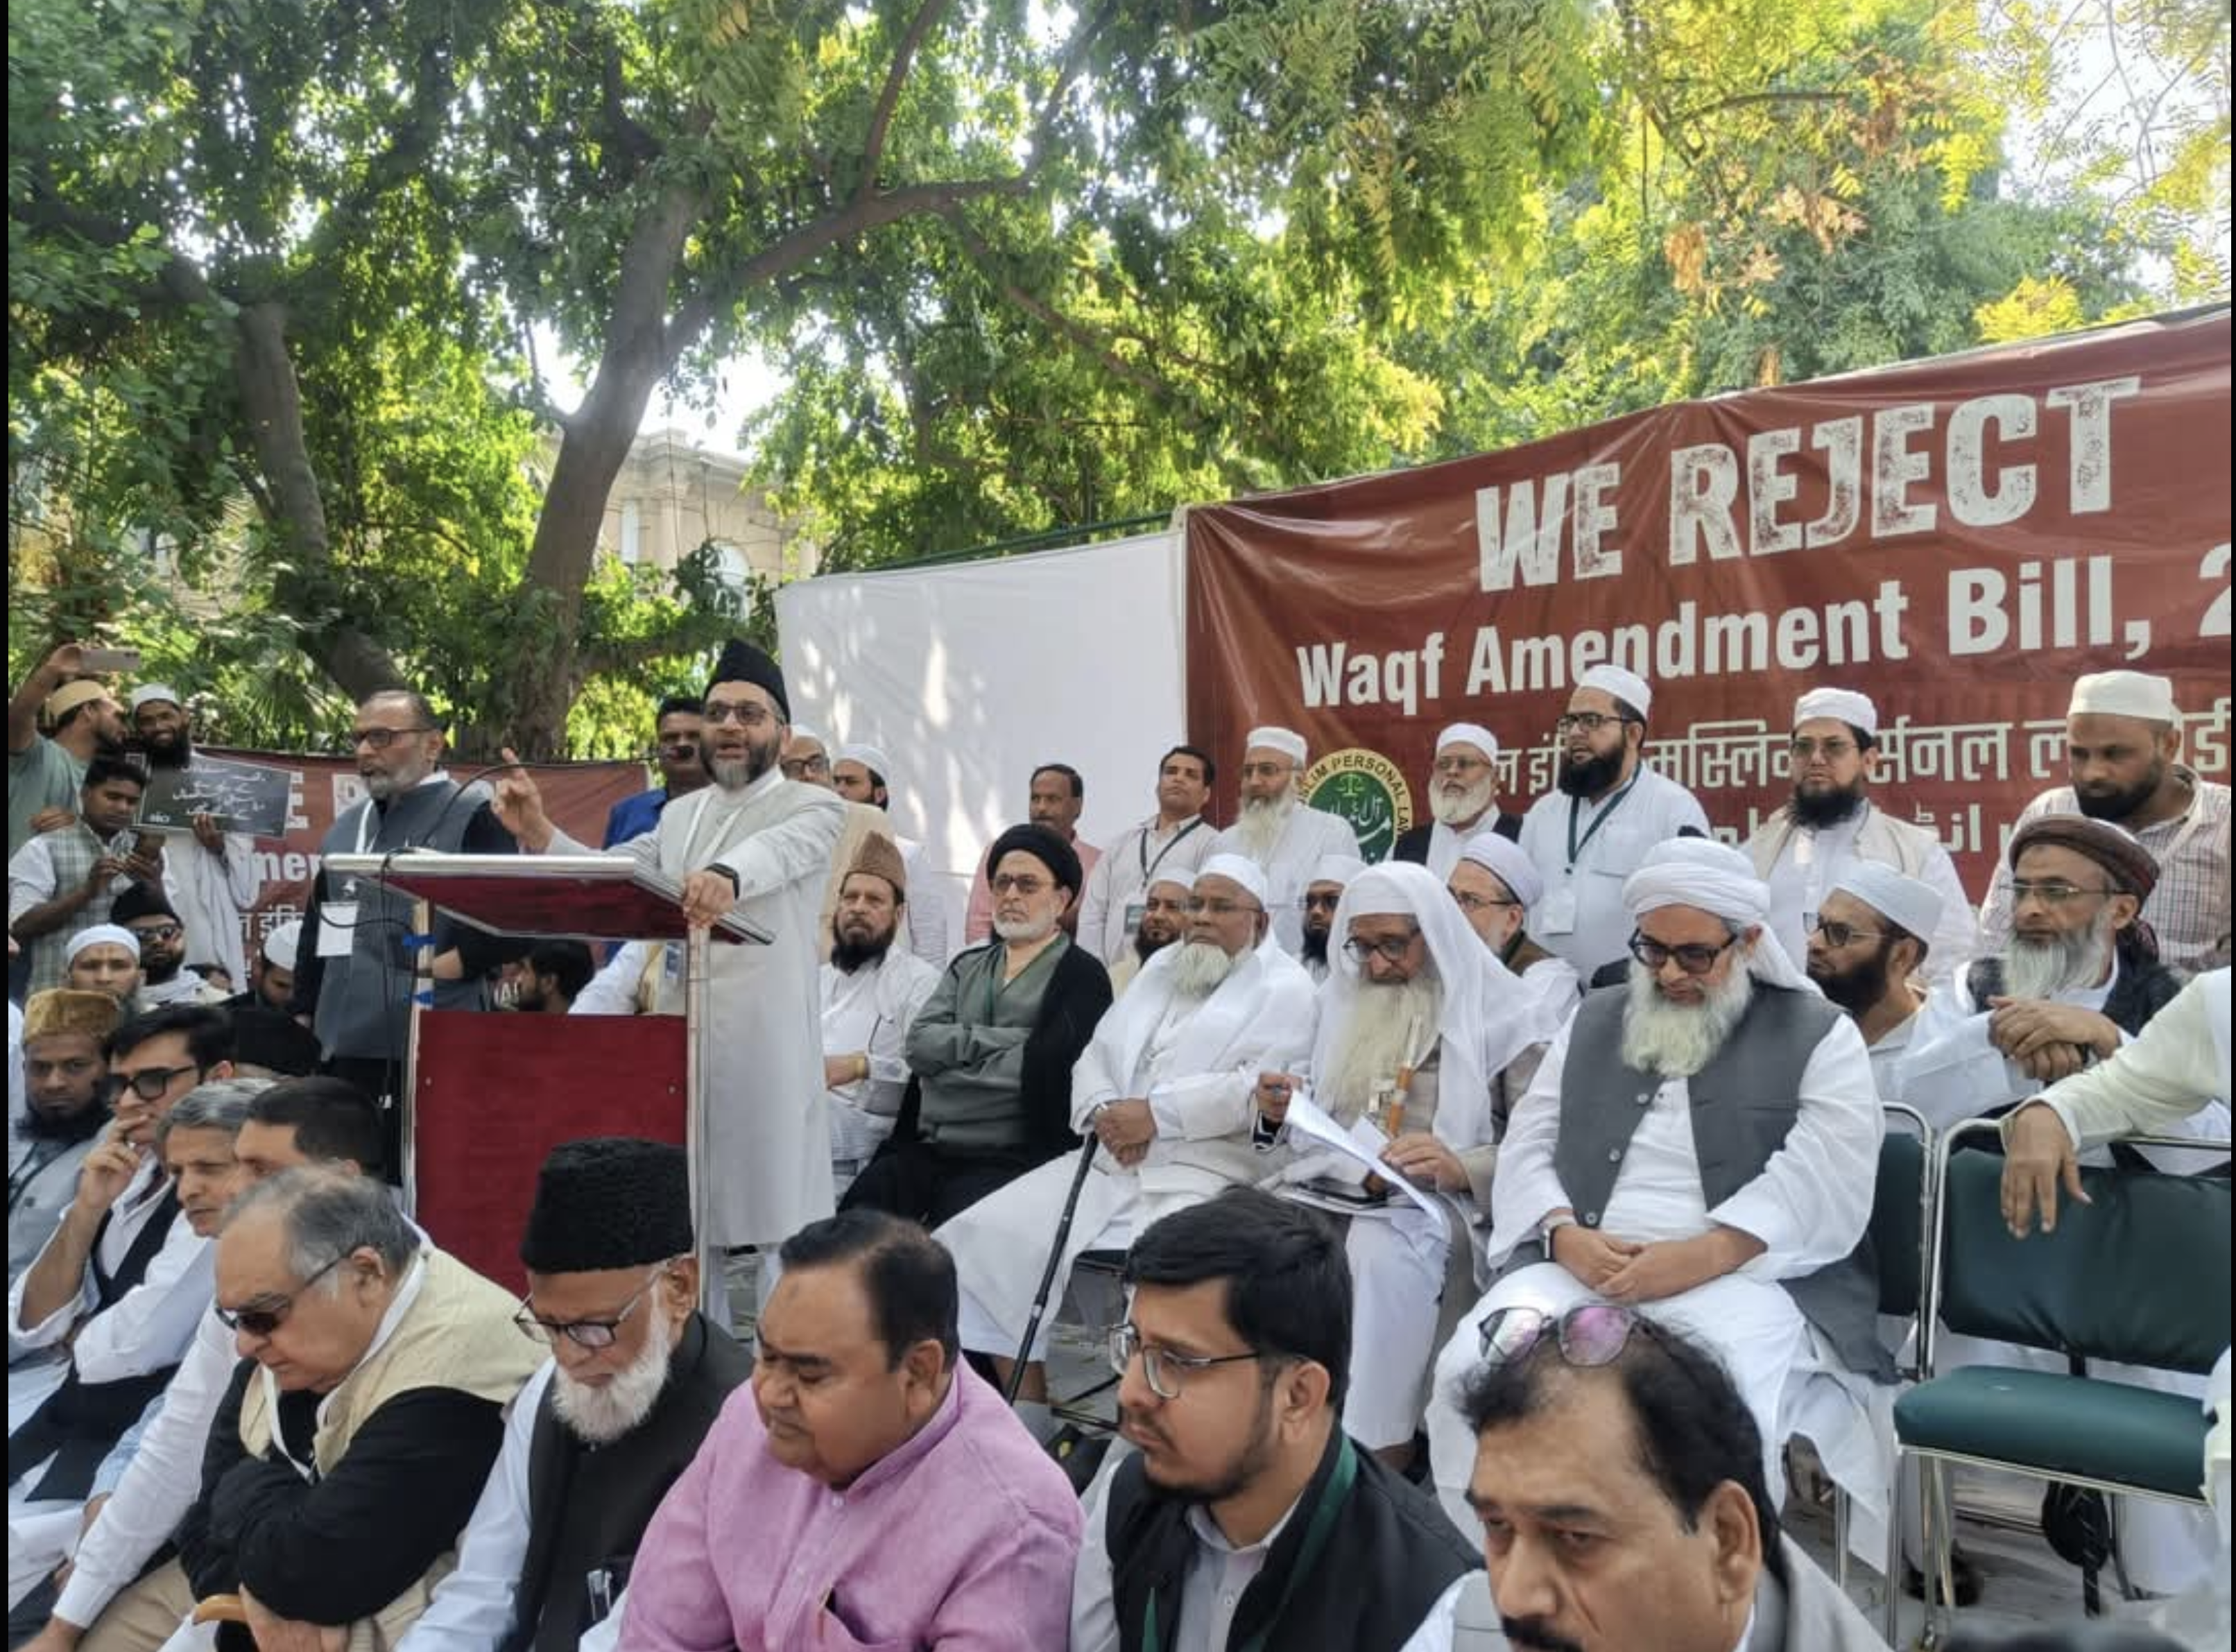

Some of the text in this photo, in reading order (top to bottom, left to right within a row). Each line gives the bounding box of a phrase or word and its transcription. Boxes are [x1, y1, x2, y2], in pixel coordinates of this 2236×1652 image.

[1477, 375, 2141, 592] WE REJECT
[1296, 631, 1445, 716] Waqf
[1465, 580, 1909, 696] Amendment
[1947, 555, 2152, 660] Bill,
[1331, 755, 1407, 802] PERSONAL
